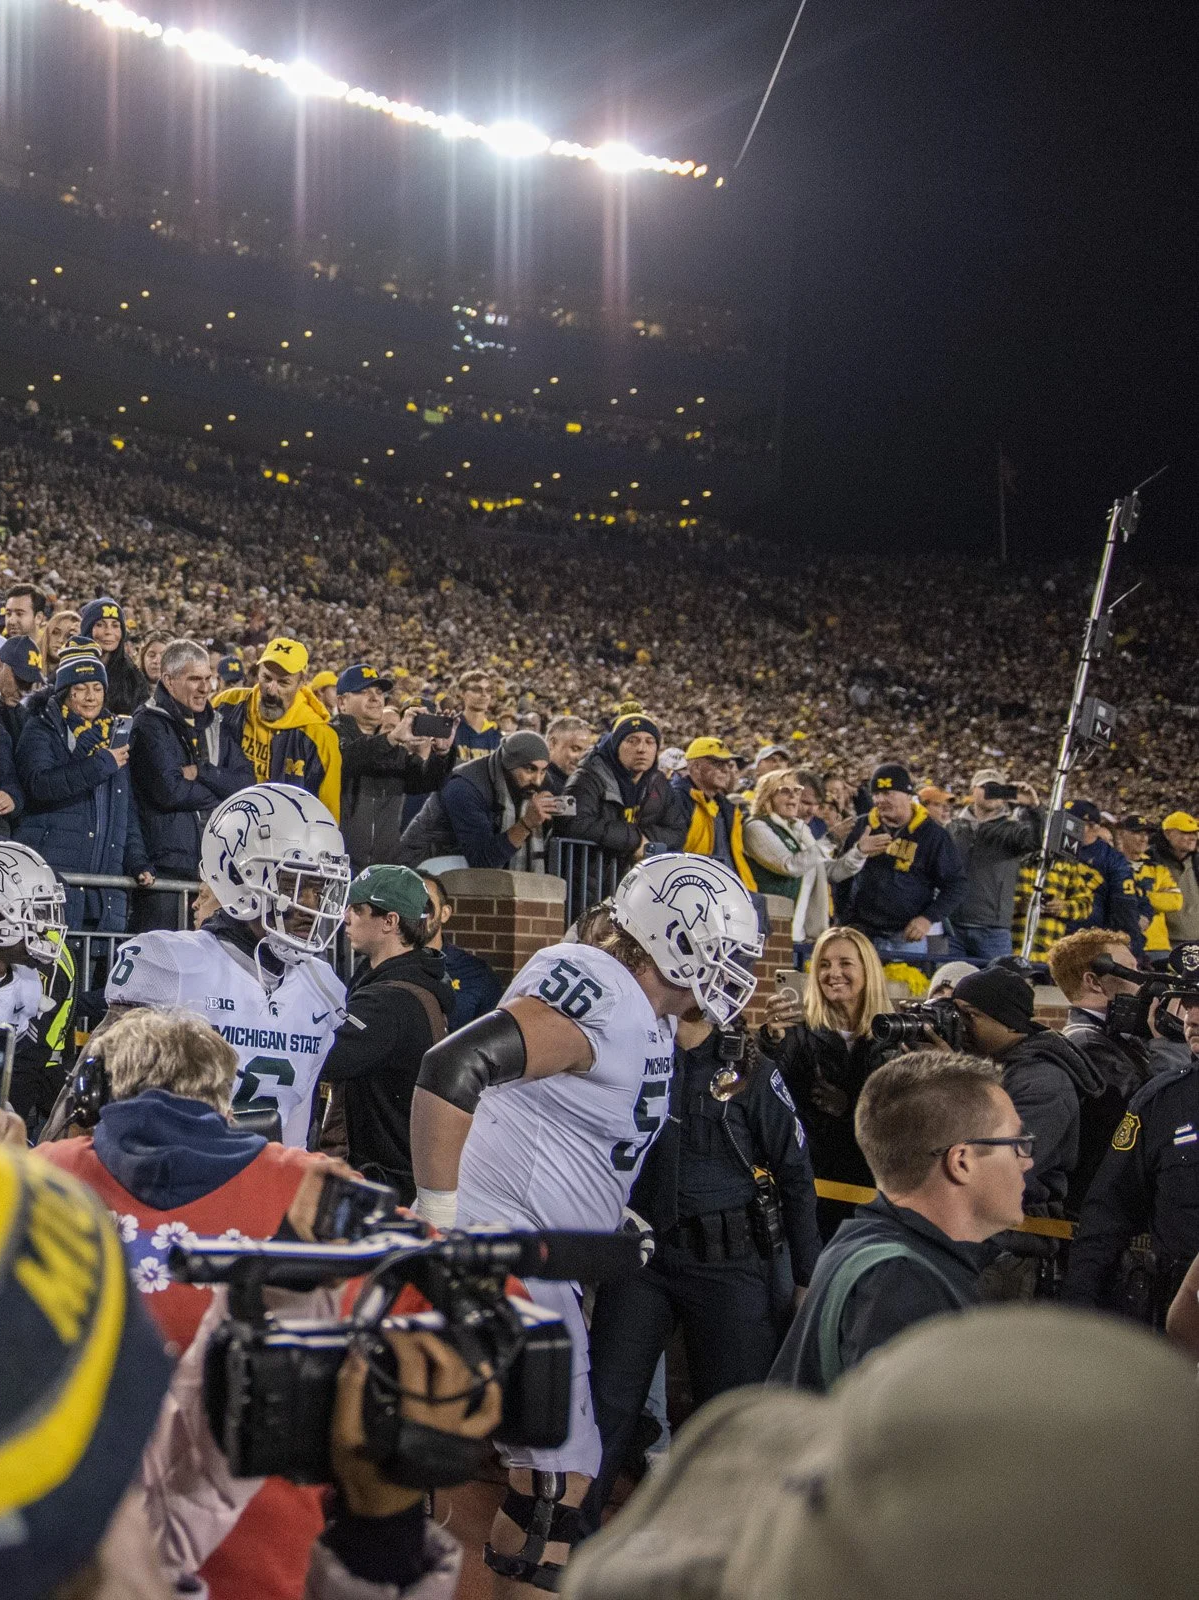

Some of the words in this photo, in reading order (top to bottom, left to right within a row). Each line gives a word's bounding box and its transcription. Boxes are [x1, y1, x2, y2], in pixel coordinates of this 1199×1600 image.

[102, 605, 118, 618] M
[274, 643, 292, 655] M
[28, 650, 43, 669] M
[361, 667, 379, 678] M
[877, 778, 892, 788] M
[111, 945, 142, 987] 6
[538, 958, 603, 1019] 56
